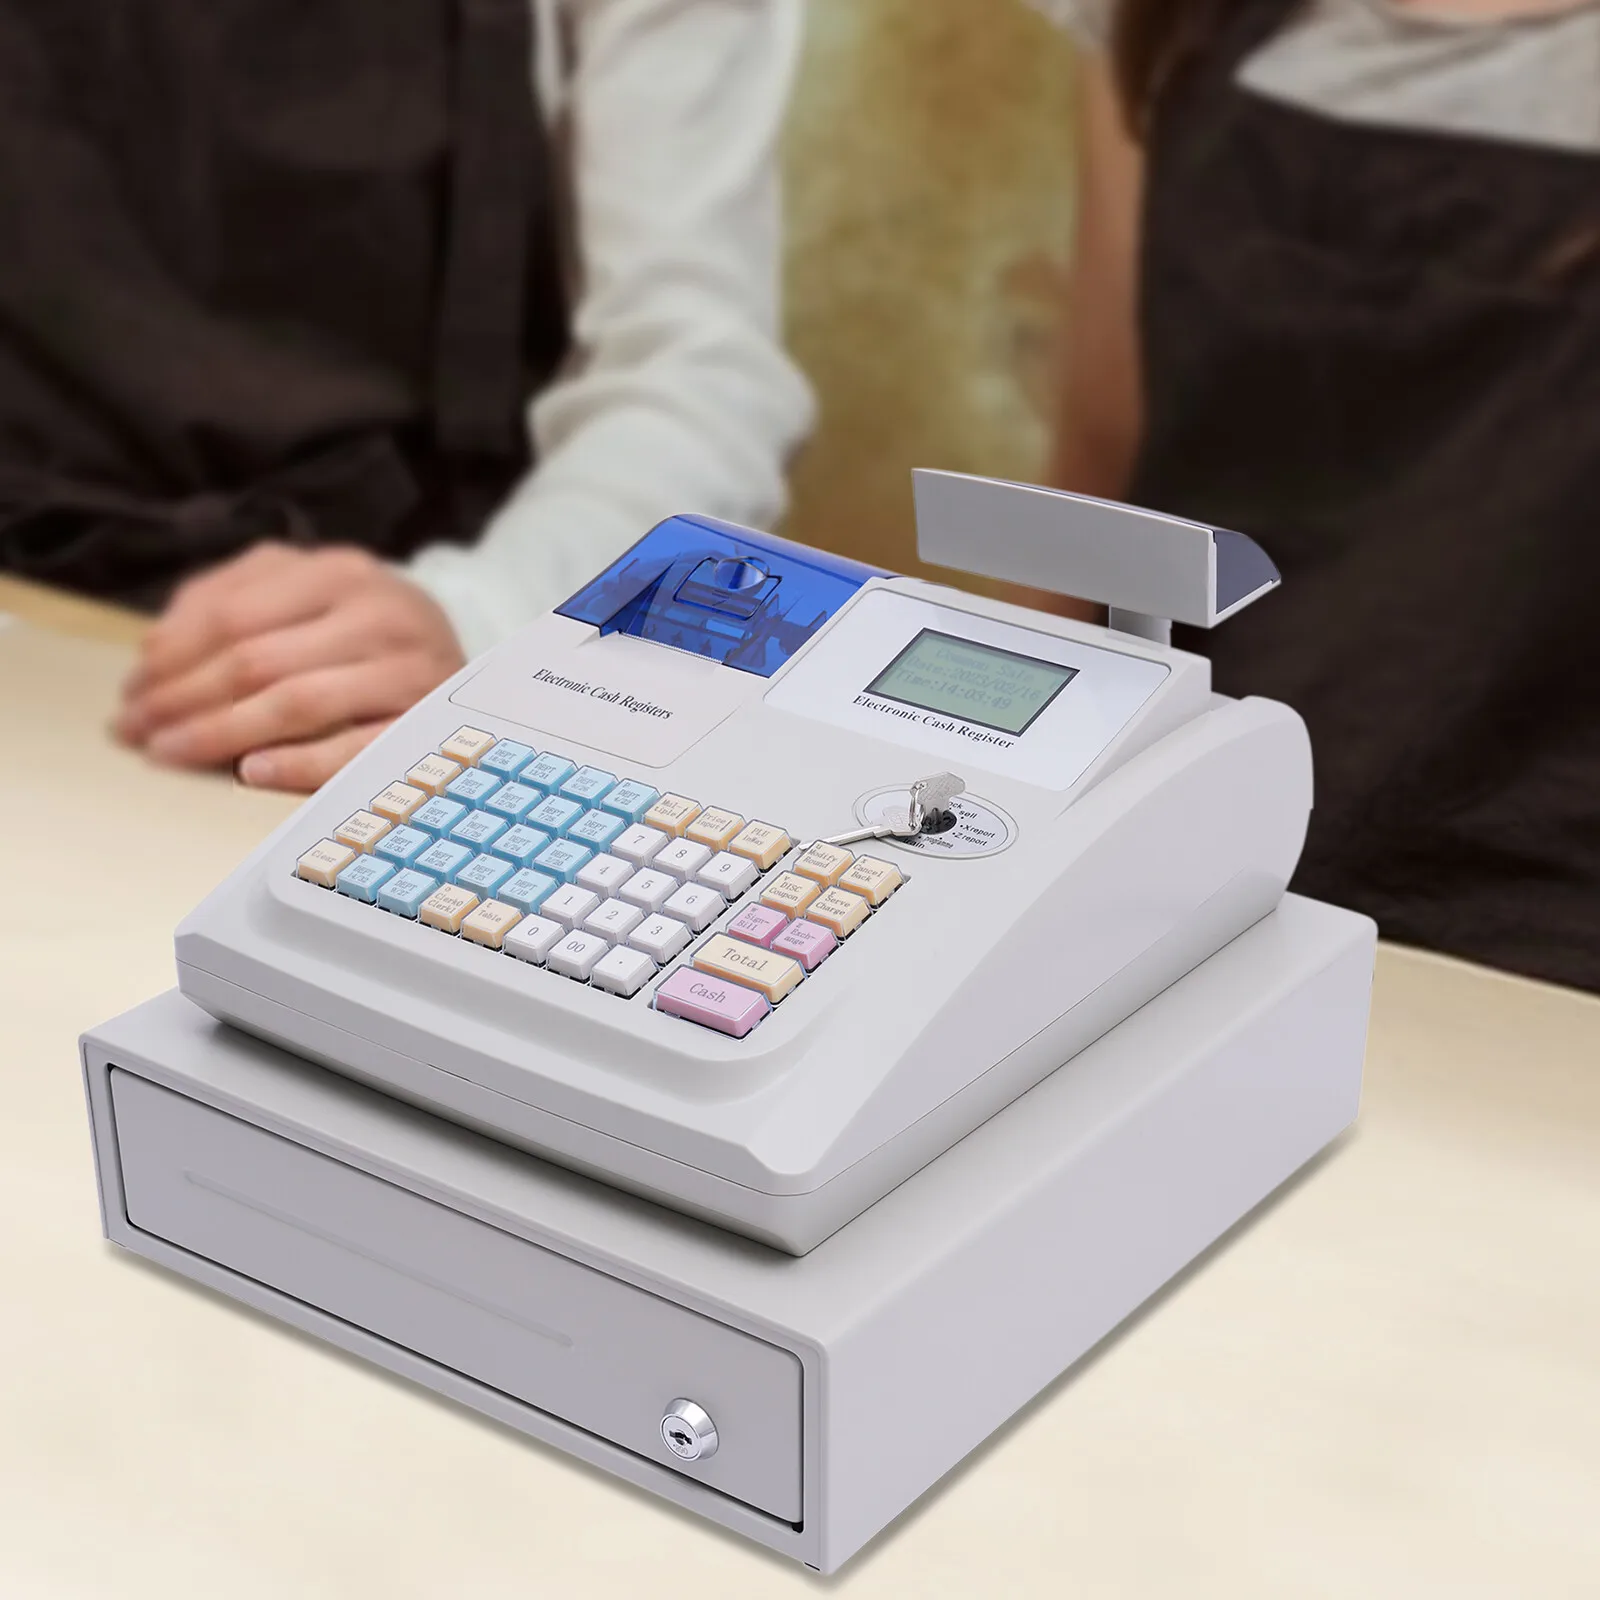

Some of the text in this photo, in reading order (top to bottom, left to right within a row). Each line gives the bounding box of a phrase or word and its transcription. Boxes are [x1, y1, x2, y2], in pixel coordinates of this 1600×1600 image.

[532, 668, 674, 720] Electronic Cash Registers
[853, 695, 1015, 749] Electronic Cash Register
[453, 735, 479, 748] Feed
[494, 748, 517, 760] DEPT
[417, 763, 446, 777] Shift
[534, 761, 557, 774] DEPT
[461, 777, 484, 790] DEPT
[575, 775, 598, 788] DEPT
[382, 791, 410, 806] Print
[500, 792, 523, 804] DEPT
[617, 789, 641, 801] DEPT
[542, 805, 565, 817] DEPT
[949, 801, 964, 810] ock
[426, 806, 448, 819] DEPT
[958, 810, 978, 819] sell
[466, 820, 489, 833] DEPT
[584, 819, 607, 831] DEPT
[342, 826, 368, 837] space
[390, 835, 413, 847] DEPT
[508, 834, 531, 846] DEPT
[633, 835, 645, 844] 7
[311, 850, 337, 863] Clear
[431, 848, 454, 861] DEPT
[550, 848, 573, 861] DEPT
[675, 849, 688, 859] 8
[807, 850, 838, 863] Modify
[719, 863, 732, 873] 9
[802, 856, 833, 869] Round
[353, 865, 376, 877] DEPT
[472, 864, 496, 876] DEPT
[599, 866, 610, 875] 4
[852, 863, 884, 878] Cancel
[850, 872, 872, 883] Back
[394, 879, 418, 892] DEPT
[514, 879, 538, 892] DEPT
[641, 880, 654, 889] 5
[779, 881, 803, 892] DISC
[685, 895, 698, 904] 6
[768, 886, 799, 901] Coupon
[563, 896, 574, 905] 1
[825, 894, 851, 908] Serve
[815, 901, 846, 916] Charge
[478, 909, 502, 923] Table
[606, 910, 619, 920] 2
[650, 925, 663, 935] 3
[736, 919, 758, 931] Bill
[527, 927, 539, 936] 0
[566, 940, 586, 953] 00
[784, 935, 805, 947] ange
[722, 948, 768, 971] Total
[689, 982, 726, 1004] Cash
